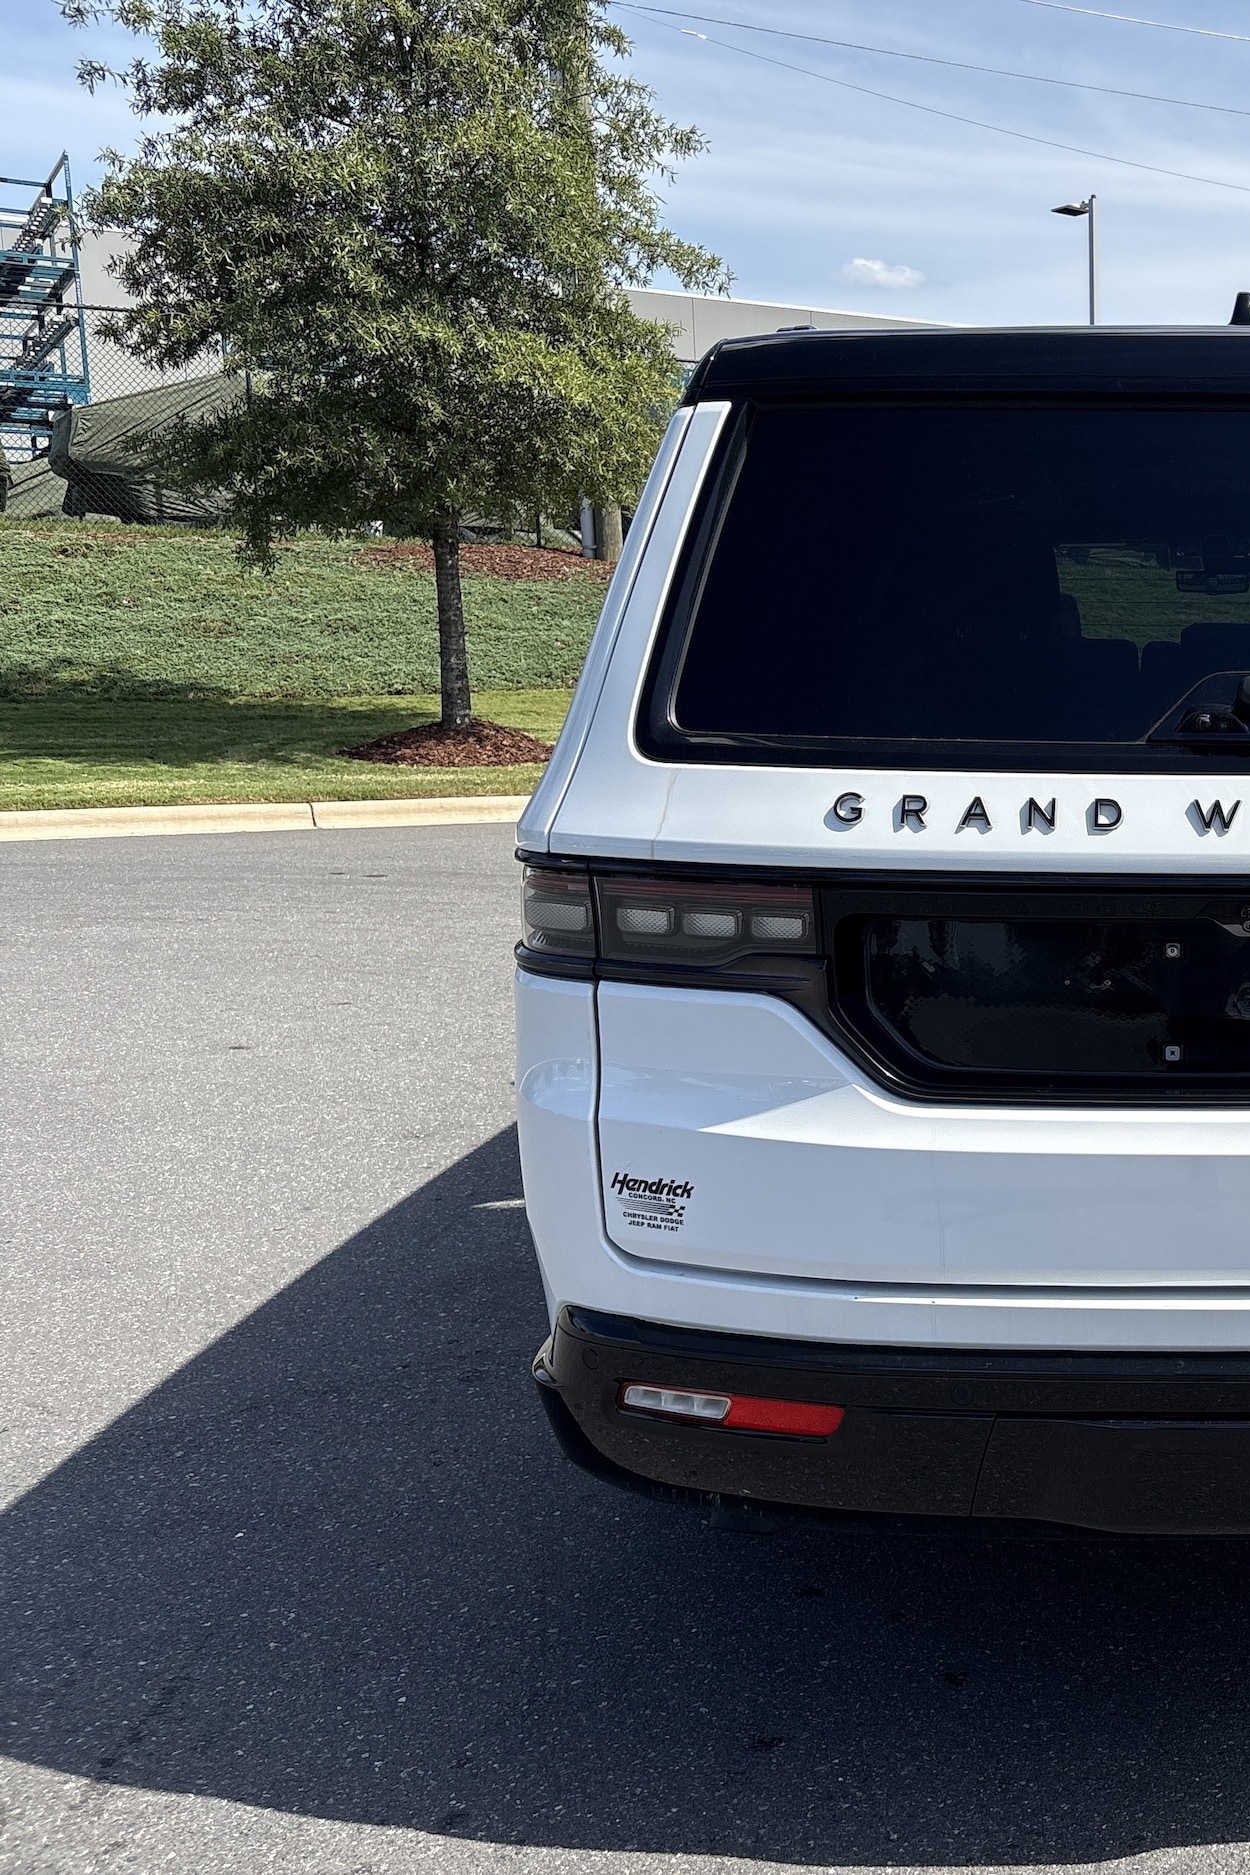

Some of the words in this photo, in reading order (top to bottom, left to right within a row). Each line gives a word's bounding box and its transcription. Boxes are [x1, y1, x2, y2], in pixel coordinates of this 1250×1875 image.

[832, 791, 1124, 831] GRAND
[610, 1172, 694, 1199] Hendrick
[623, 1211, 658, 1222] CHRYSLER
[660, 1217, 684, 1226] DODGE
[647, 1222, 662, 1230] RAM
